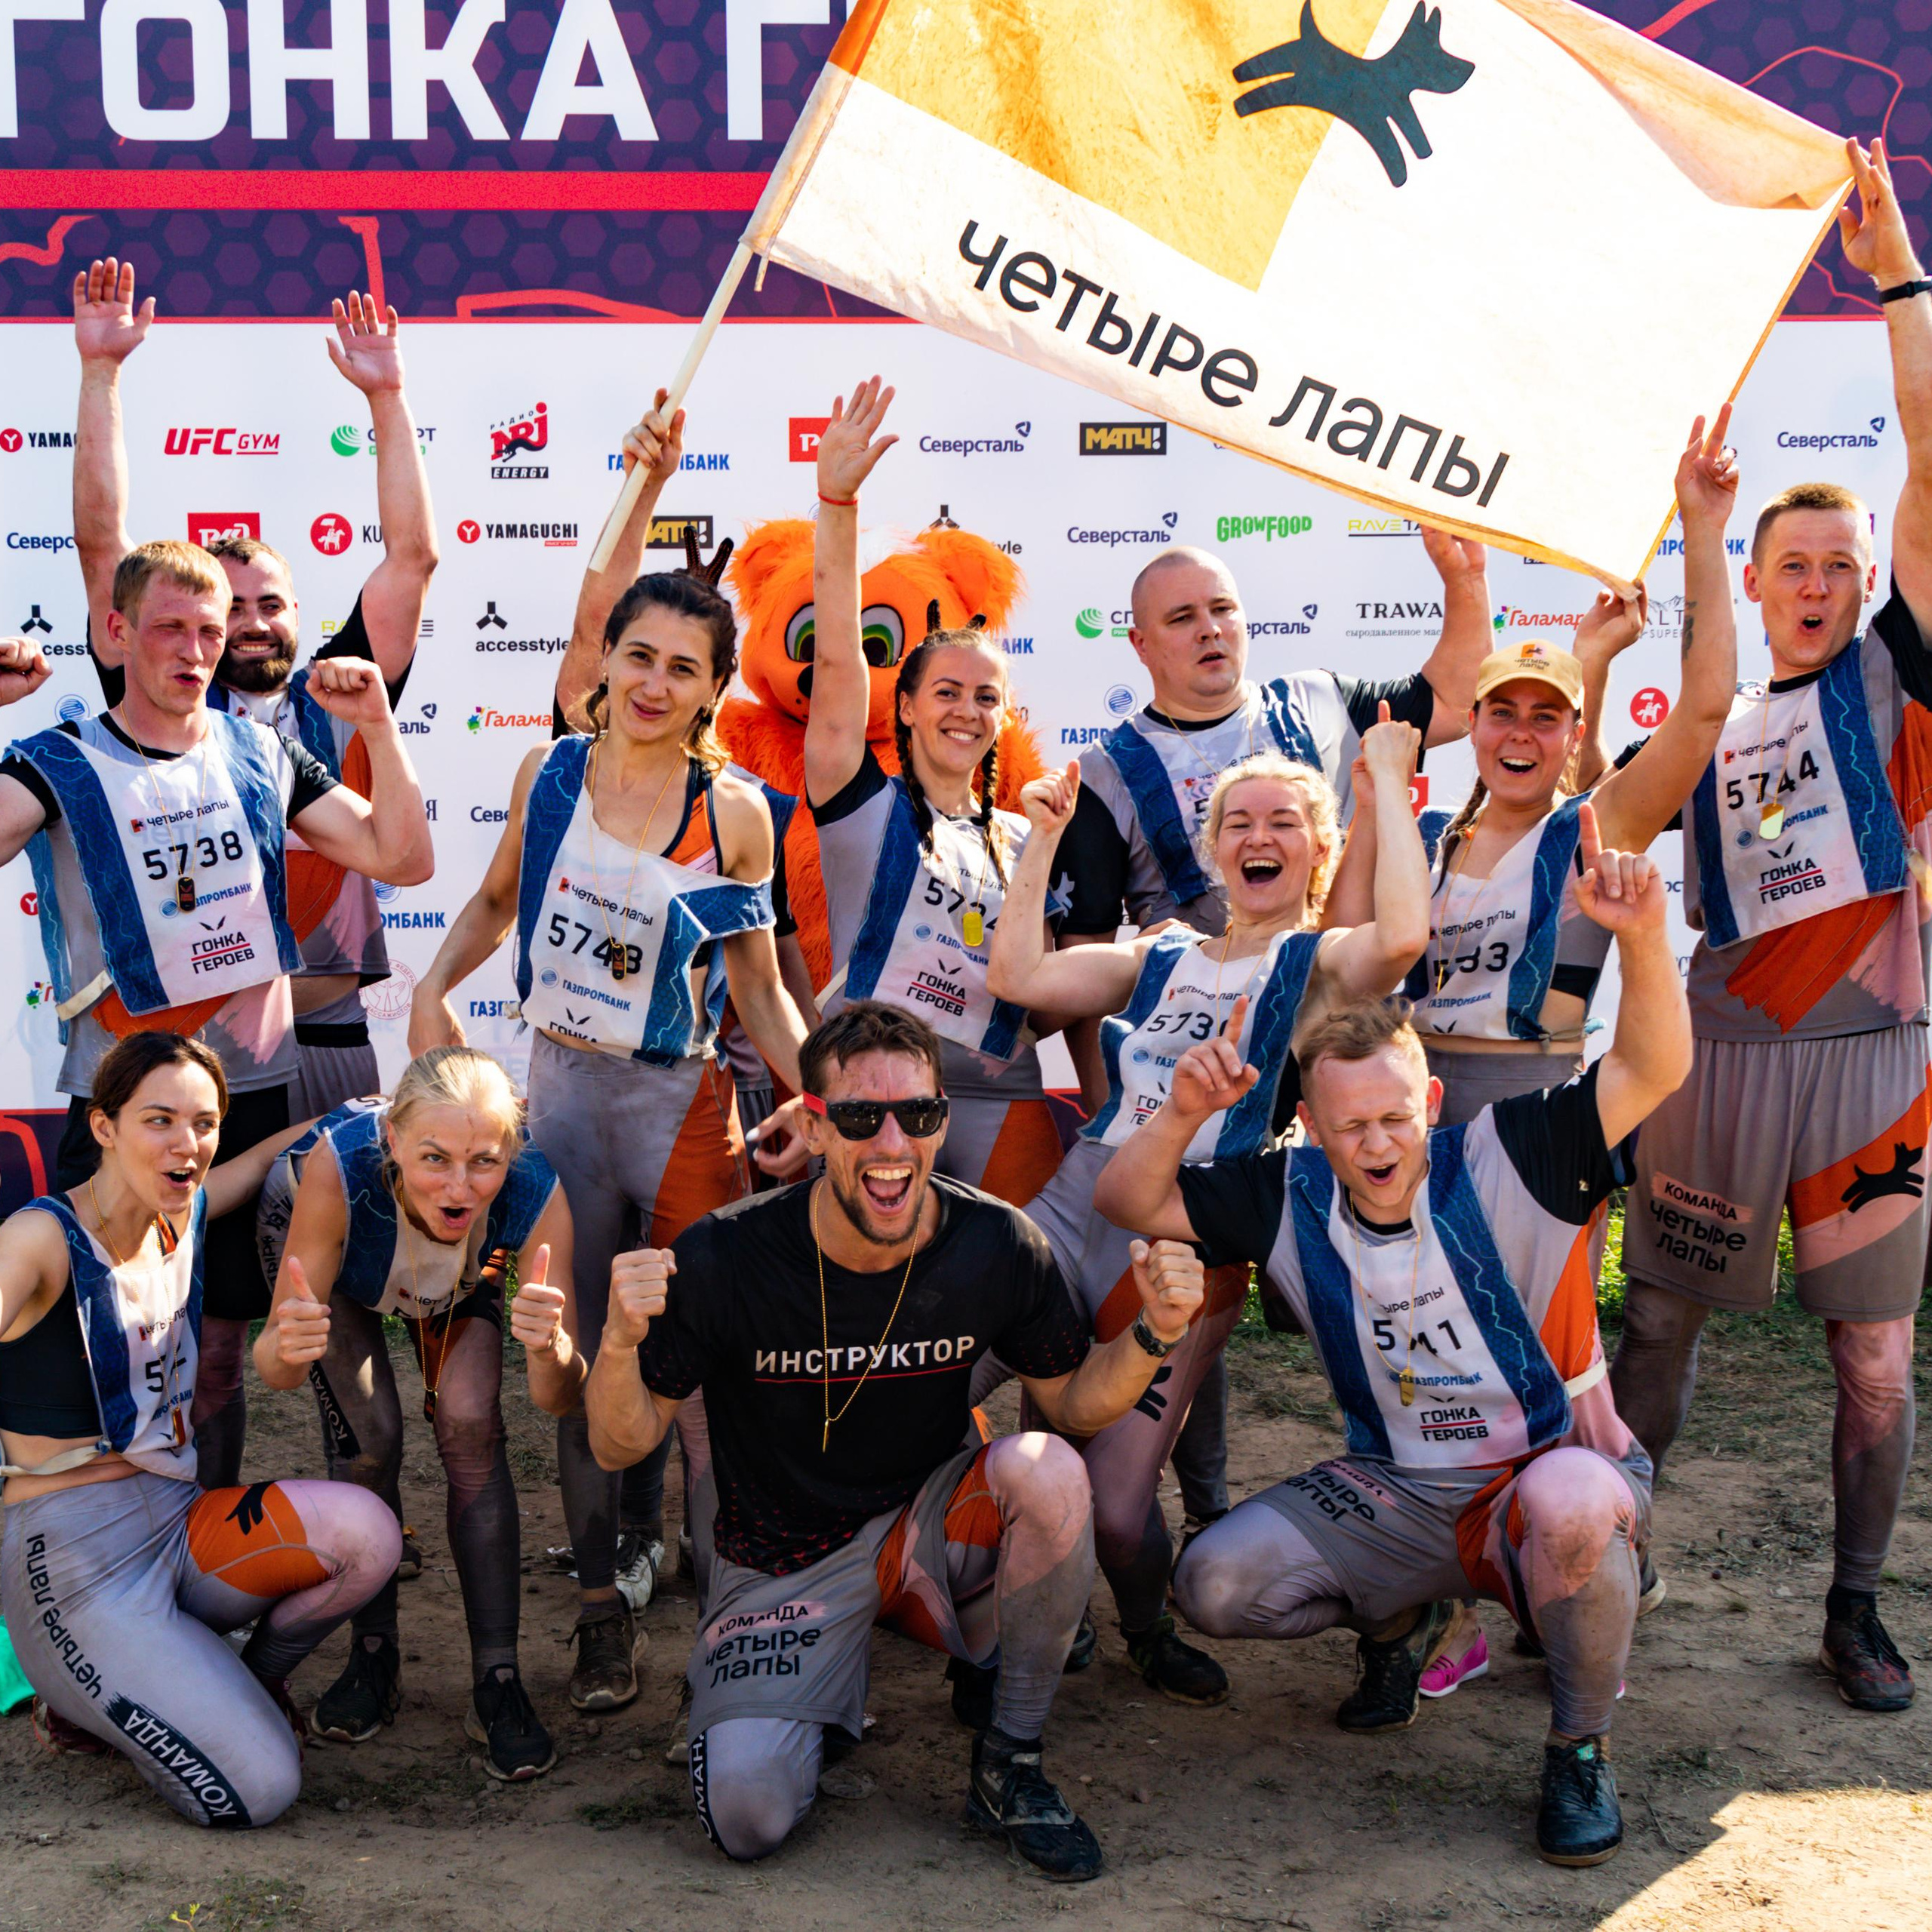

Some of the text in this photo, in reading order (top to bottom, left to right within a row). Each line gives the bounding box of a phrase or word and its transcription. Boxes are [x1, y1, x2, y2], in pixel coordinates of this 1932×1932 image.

[958, 220, 1510, 508] четыре лапы
[491, 410, 534, 430] РАДИО
[164, 428, 281, 456] UFC GYM
[919, 435, 1025, 457] Северсталь
[1777, 432, 1878, 452] Северсталь
[492, 467, 549, 478] ENERGY
[486, 523, 578, 539] YAMAGUCHI
[1066, 526, 1171, 548] Северсталь
[1217, 515, 1313, 543] GROWFOOD
[1355, 602, 1444, 619] TRAWA
[1346, 627, 1421, 638] сыродавленное
[1727, 749, 1820, 811] 5744
[146, 809, 194, 828] четыре
[196, 799, 229, 818] лапы
[142, 829, 244, 881] 5738
[1760, 857, 1817, 884] ГОНКА
[1760, 875, 1827, 905] ГЕРОЕВ
[571, 884, 654, 926] четыре лапы
[192, 931, 246, 955] ГОНКА
[192, 947, 255, 974] ГЕРОЕВ
[562, 979, 632, 1011] ГАЗПРОМБАНК
[916, 971, 966, 1000] ГОНКА
[906, 986, 965, 1017] ГЕРОЕВ
[1664, 1181, 1737, 1221] КОМАНДА
[1650, 1199, 1747, 1252] четыре
[1656, 1232, 1727, 1274] лапы
[1413, 1287, 1445, 1308] лапы
[755, 1335, 976, 1374] ИНСТРУКТОР
[1420, 1406, 1481, 1425] ГОНКА
[1420, 1425, 1489, 1442] ГЕРОЕВ
[717, 1604, 809, 1638] КОМАНДА
[705, 1628, 822, 1667] четыре
[26, 1533, 238, 1817] КОМАНДА четыре лапы
[709, 1654, 801, 1689] лапы
